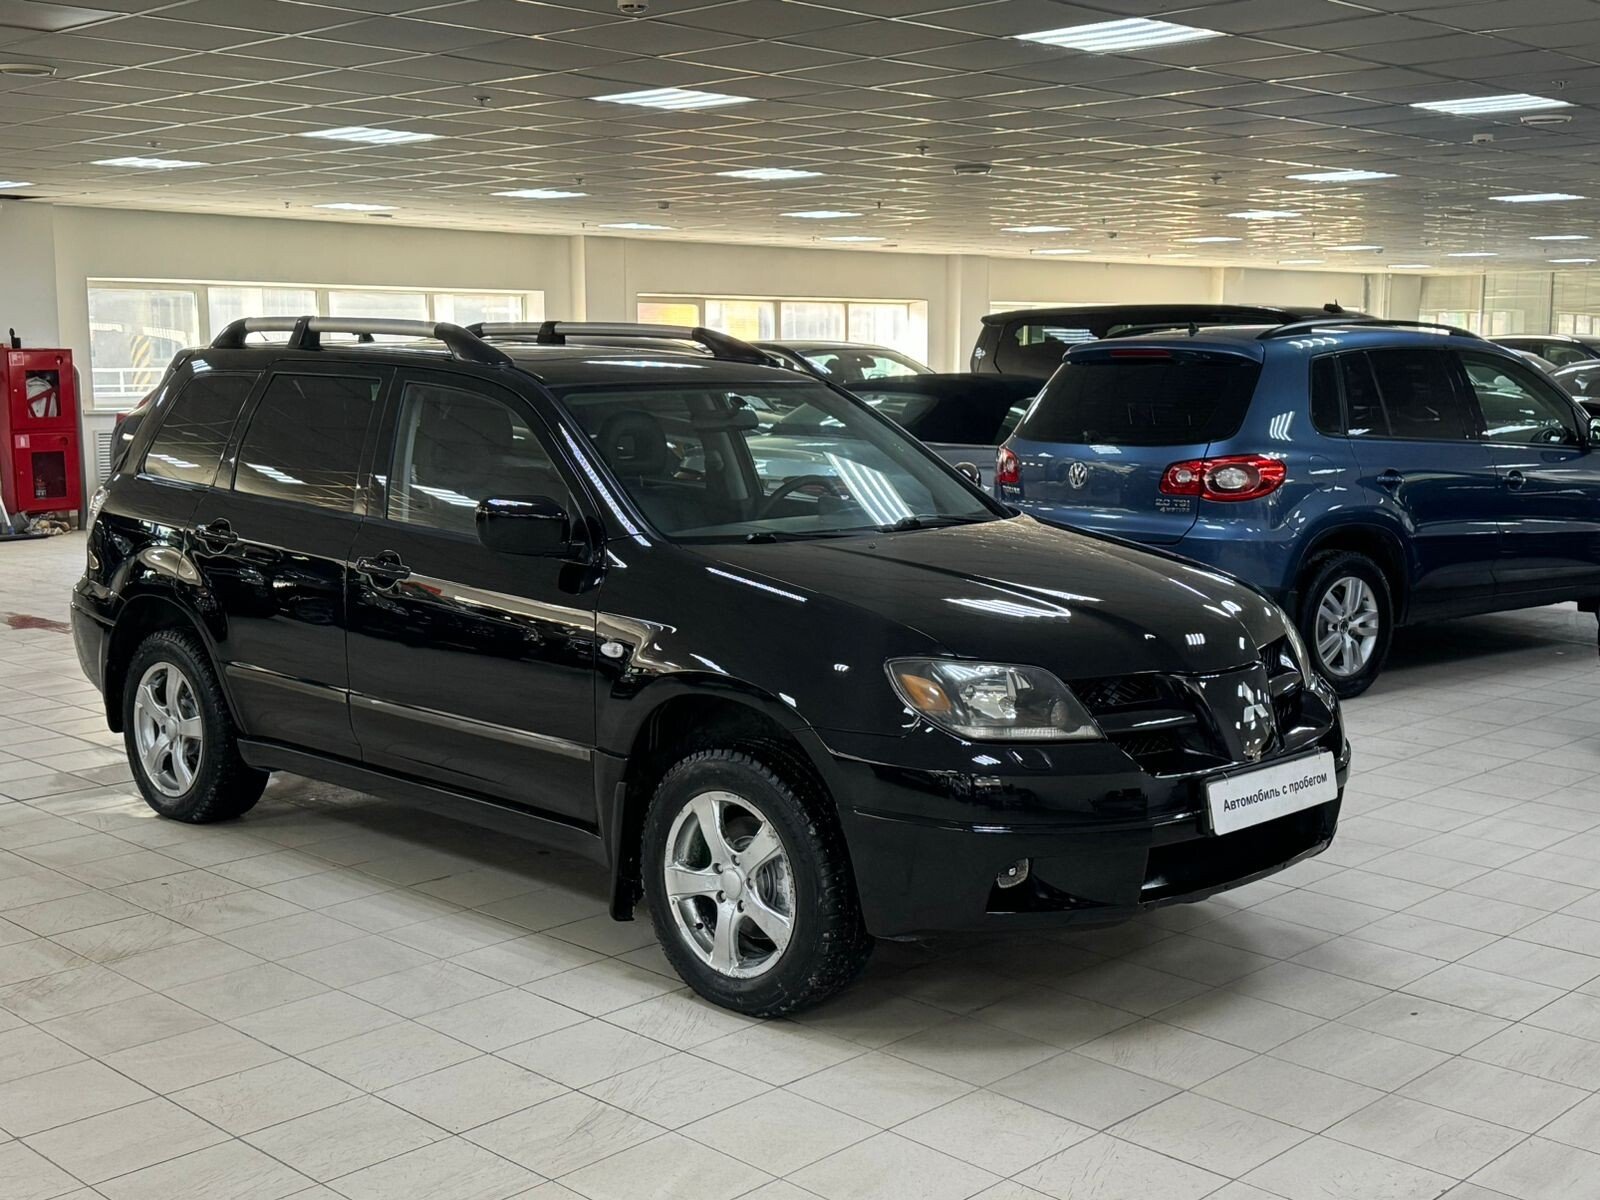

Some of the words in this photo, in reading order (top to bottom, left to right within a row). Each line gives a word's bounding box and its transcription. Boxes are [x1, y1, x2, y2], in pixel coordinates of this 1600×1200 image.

[1223, 788, 1280, 812] Автомобиль
[1281, 785, 1288, 795] с
[1289, 772, 1328, 794] пробегом
